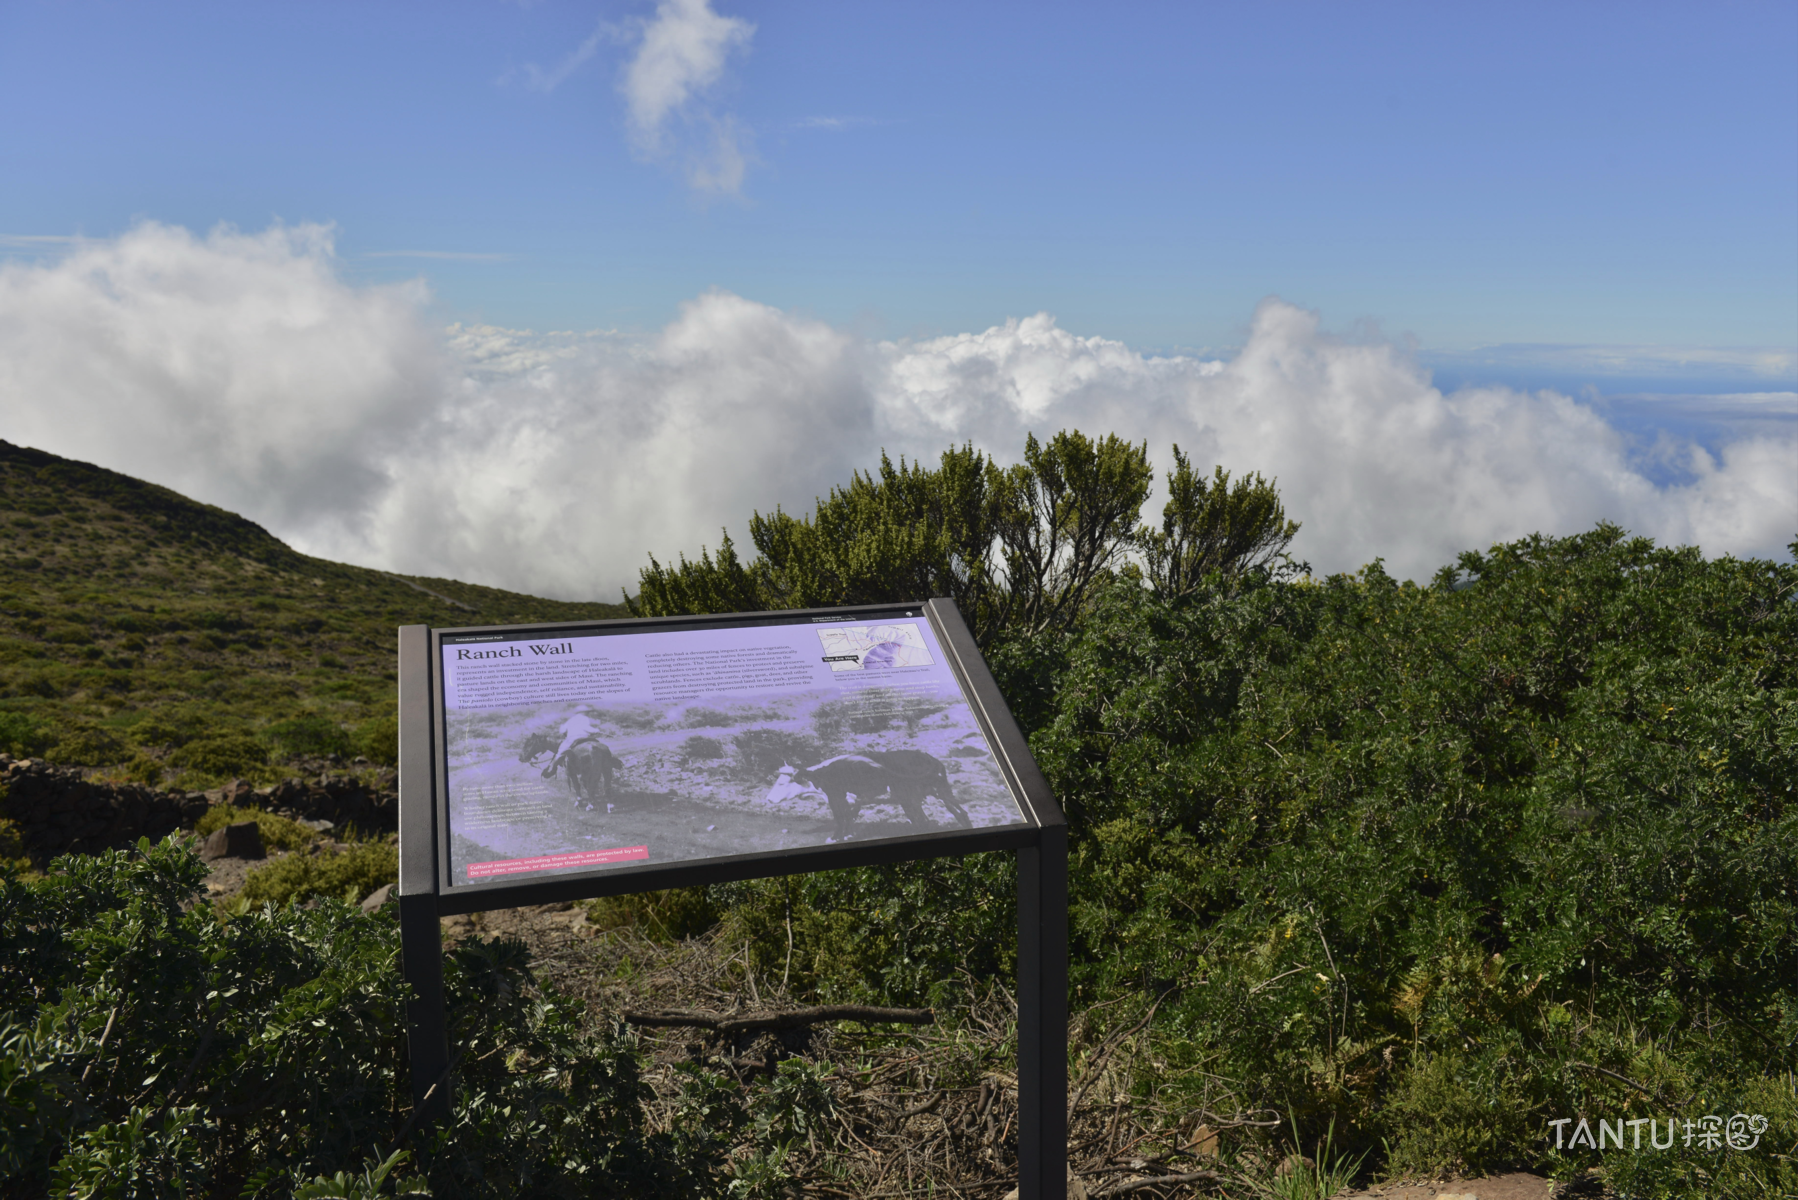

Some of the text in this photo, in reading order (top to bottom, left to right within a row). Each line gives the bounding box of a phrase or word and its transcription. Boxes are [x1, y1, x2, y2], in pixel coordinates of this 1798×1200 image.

[456, 643, 574, 660] Ranch Wall
[596, 850, 623, 858] protected
